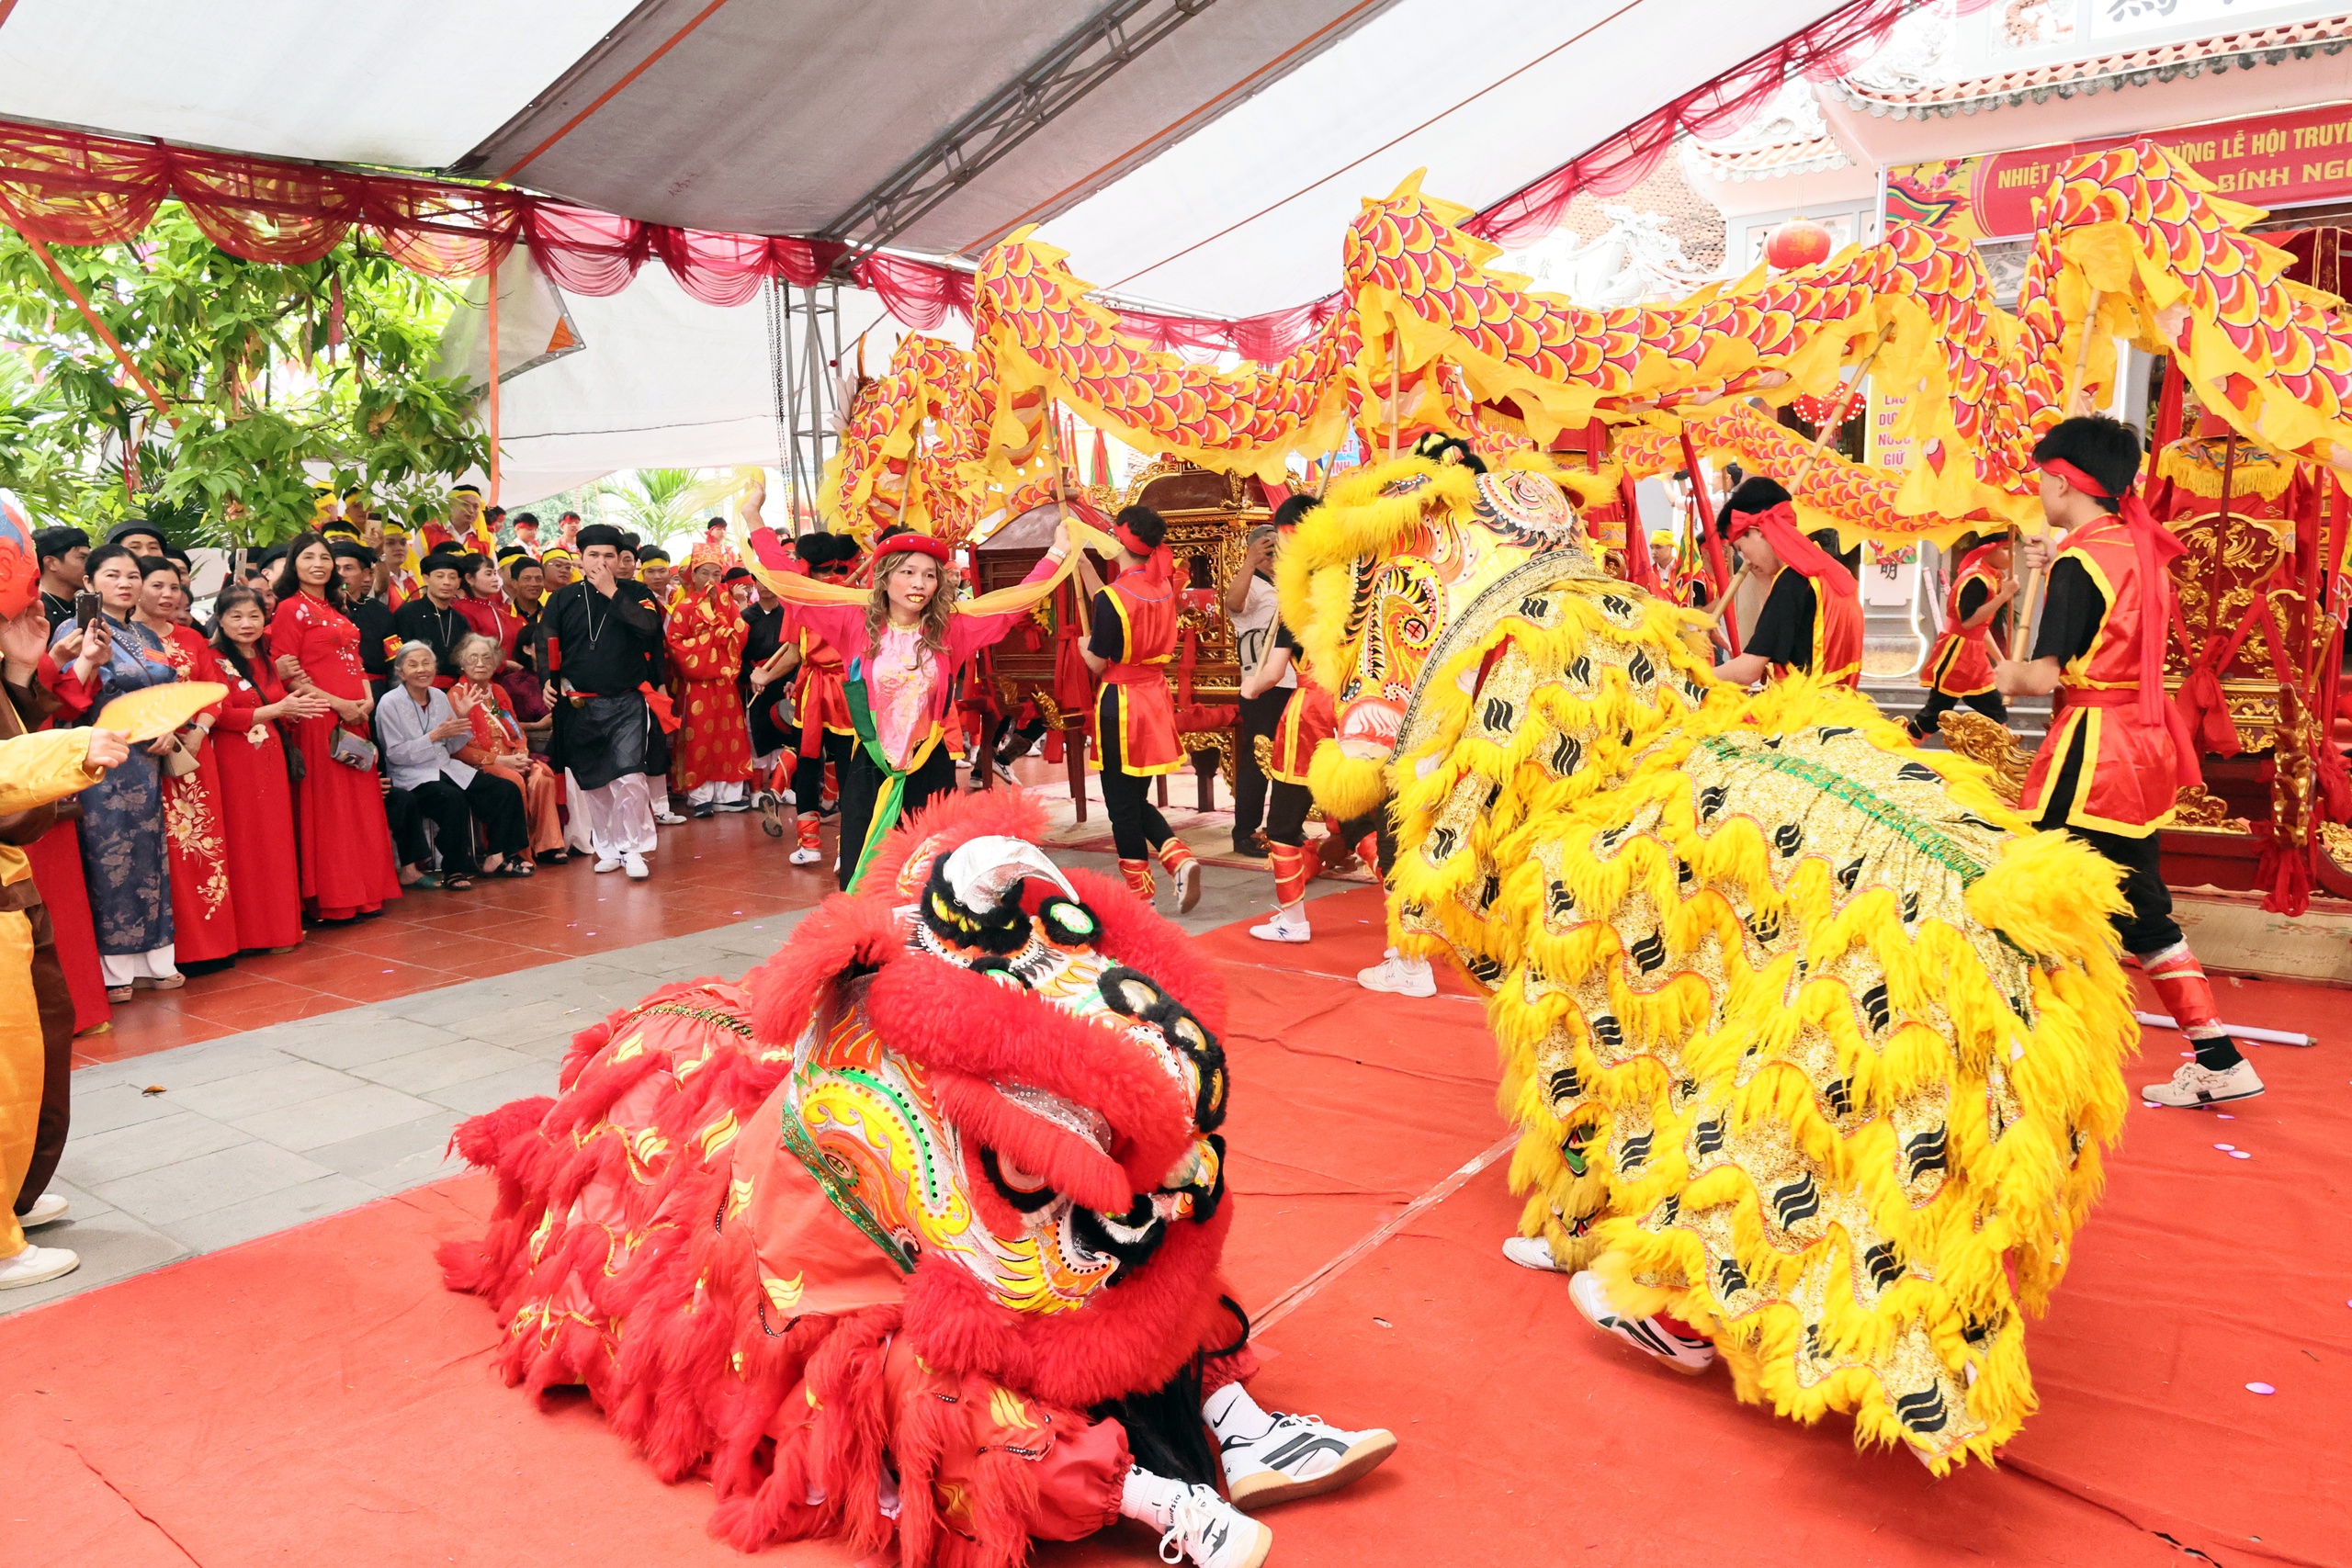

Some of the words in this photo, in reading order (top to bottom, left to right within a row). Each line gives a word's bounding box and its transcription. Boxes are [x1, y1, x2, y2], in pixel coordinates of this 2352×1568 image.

[1997, 162, 2051, 188] NHIỆT
[2166, 140, 2216, 164] ỪNG
[2222, 130, 2245, 159] LỄ
[2251, 128, 2287, 157] HỘI
[2217, 167, 2290, 194] BÍNH
[1883, 450, 1905, 466] GIỮ
